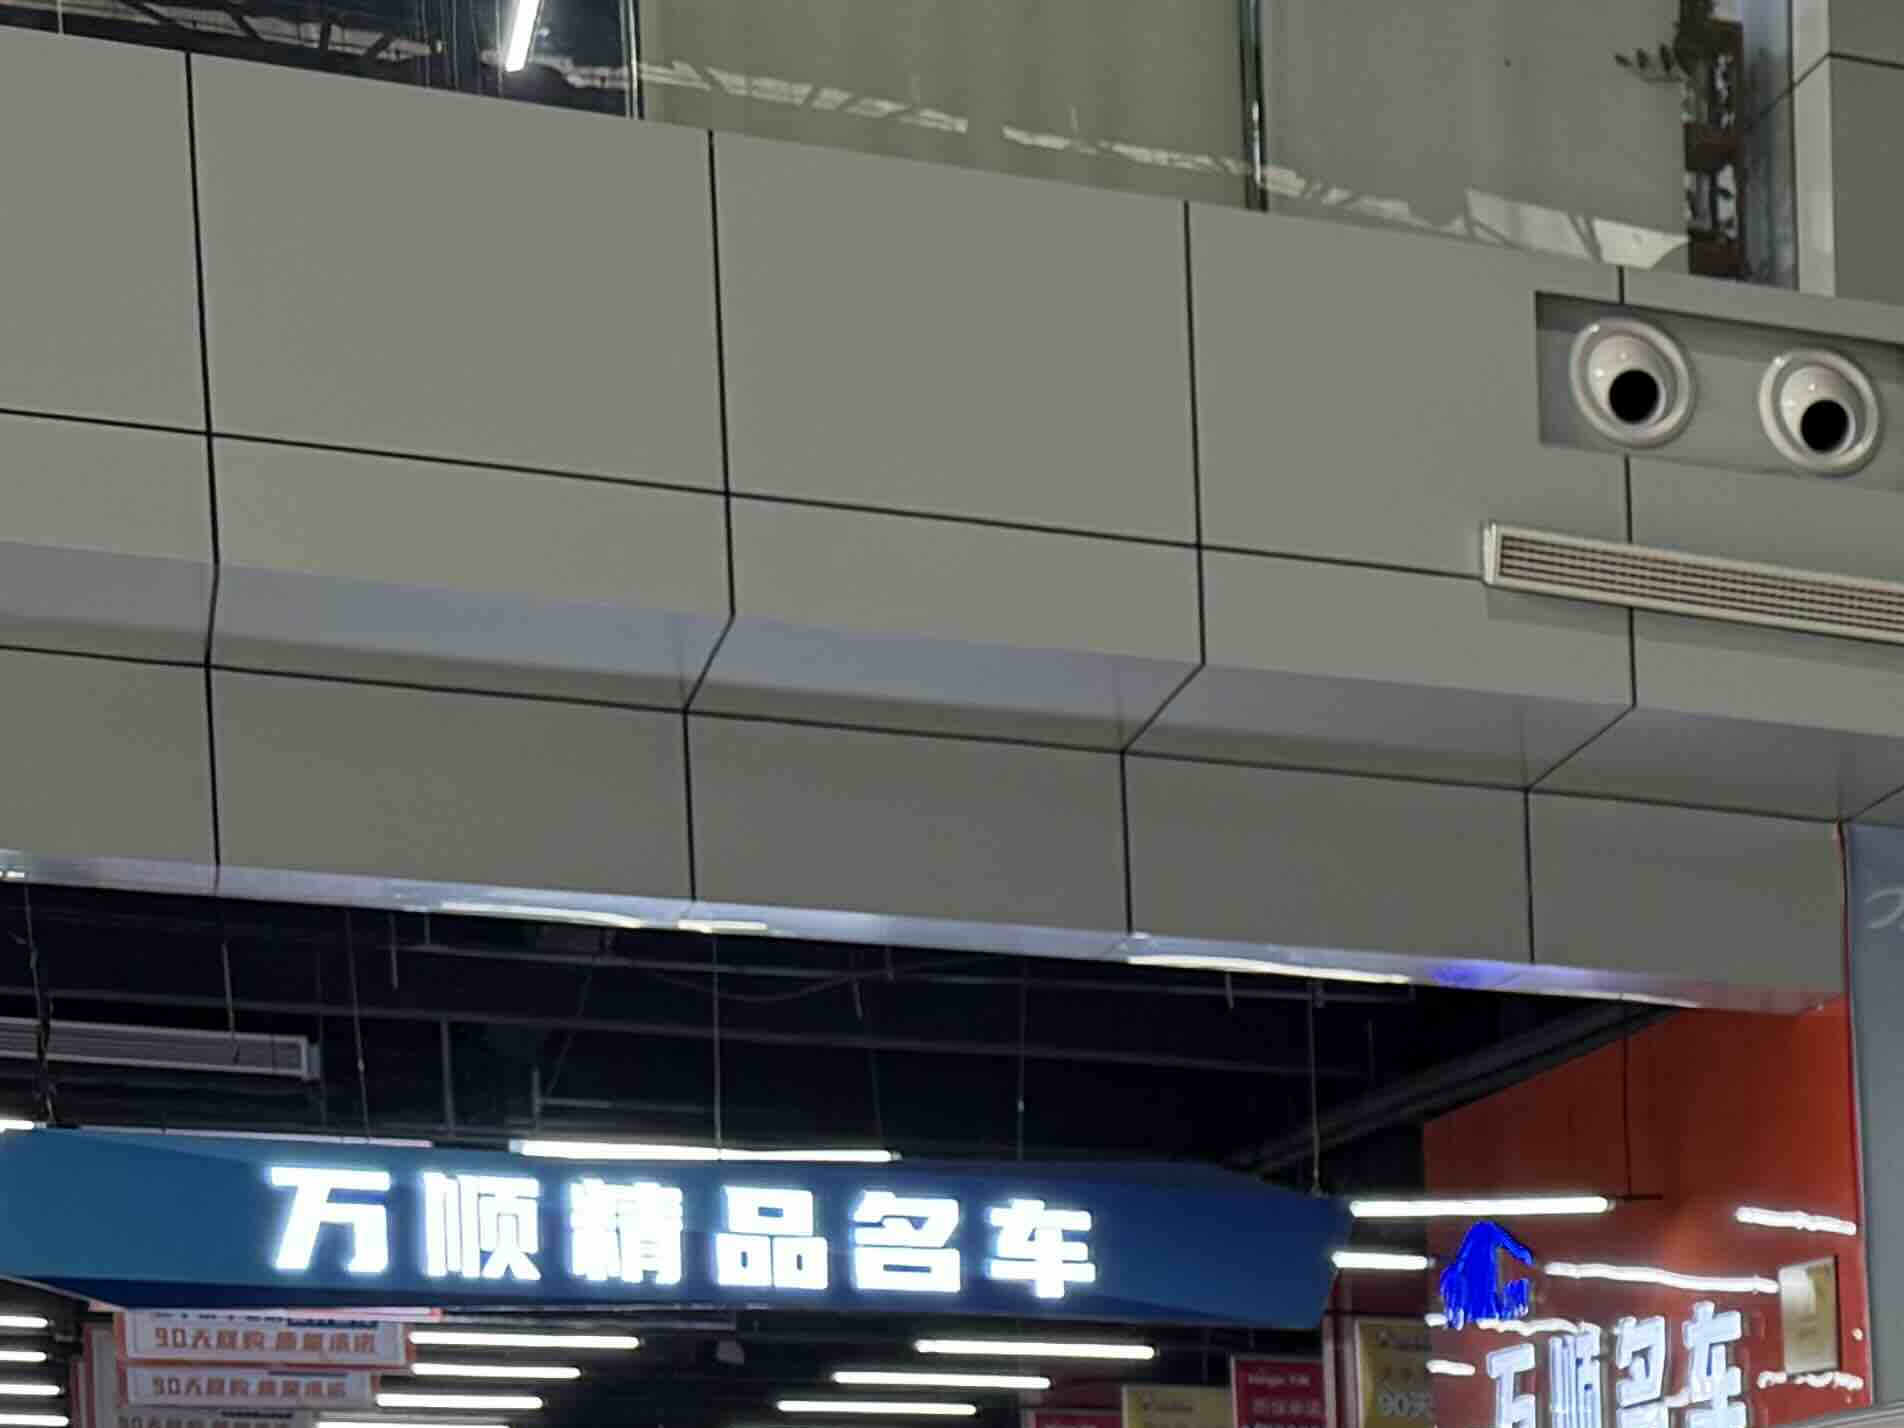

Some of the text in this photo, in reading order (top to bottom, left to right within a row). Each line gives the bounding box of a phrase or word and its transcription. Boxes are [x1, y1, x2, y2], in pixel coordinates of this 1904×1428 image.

[266, 1165, 1097, 1300] 万顺精品名车
